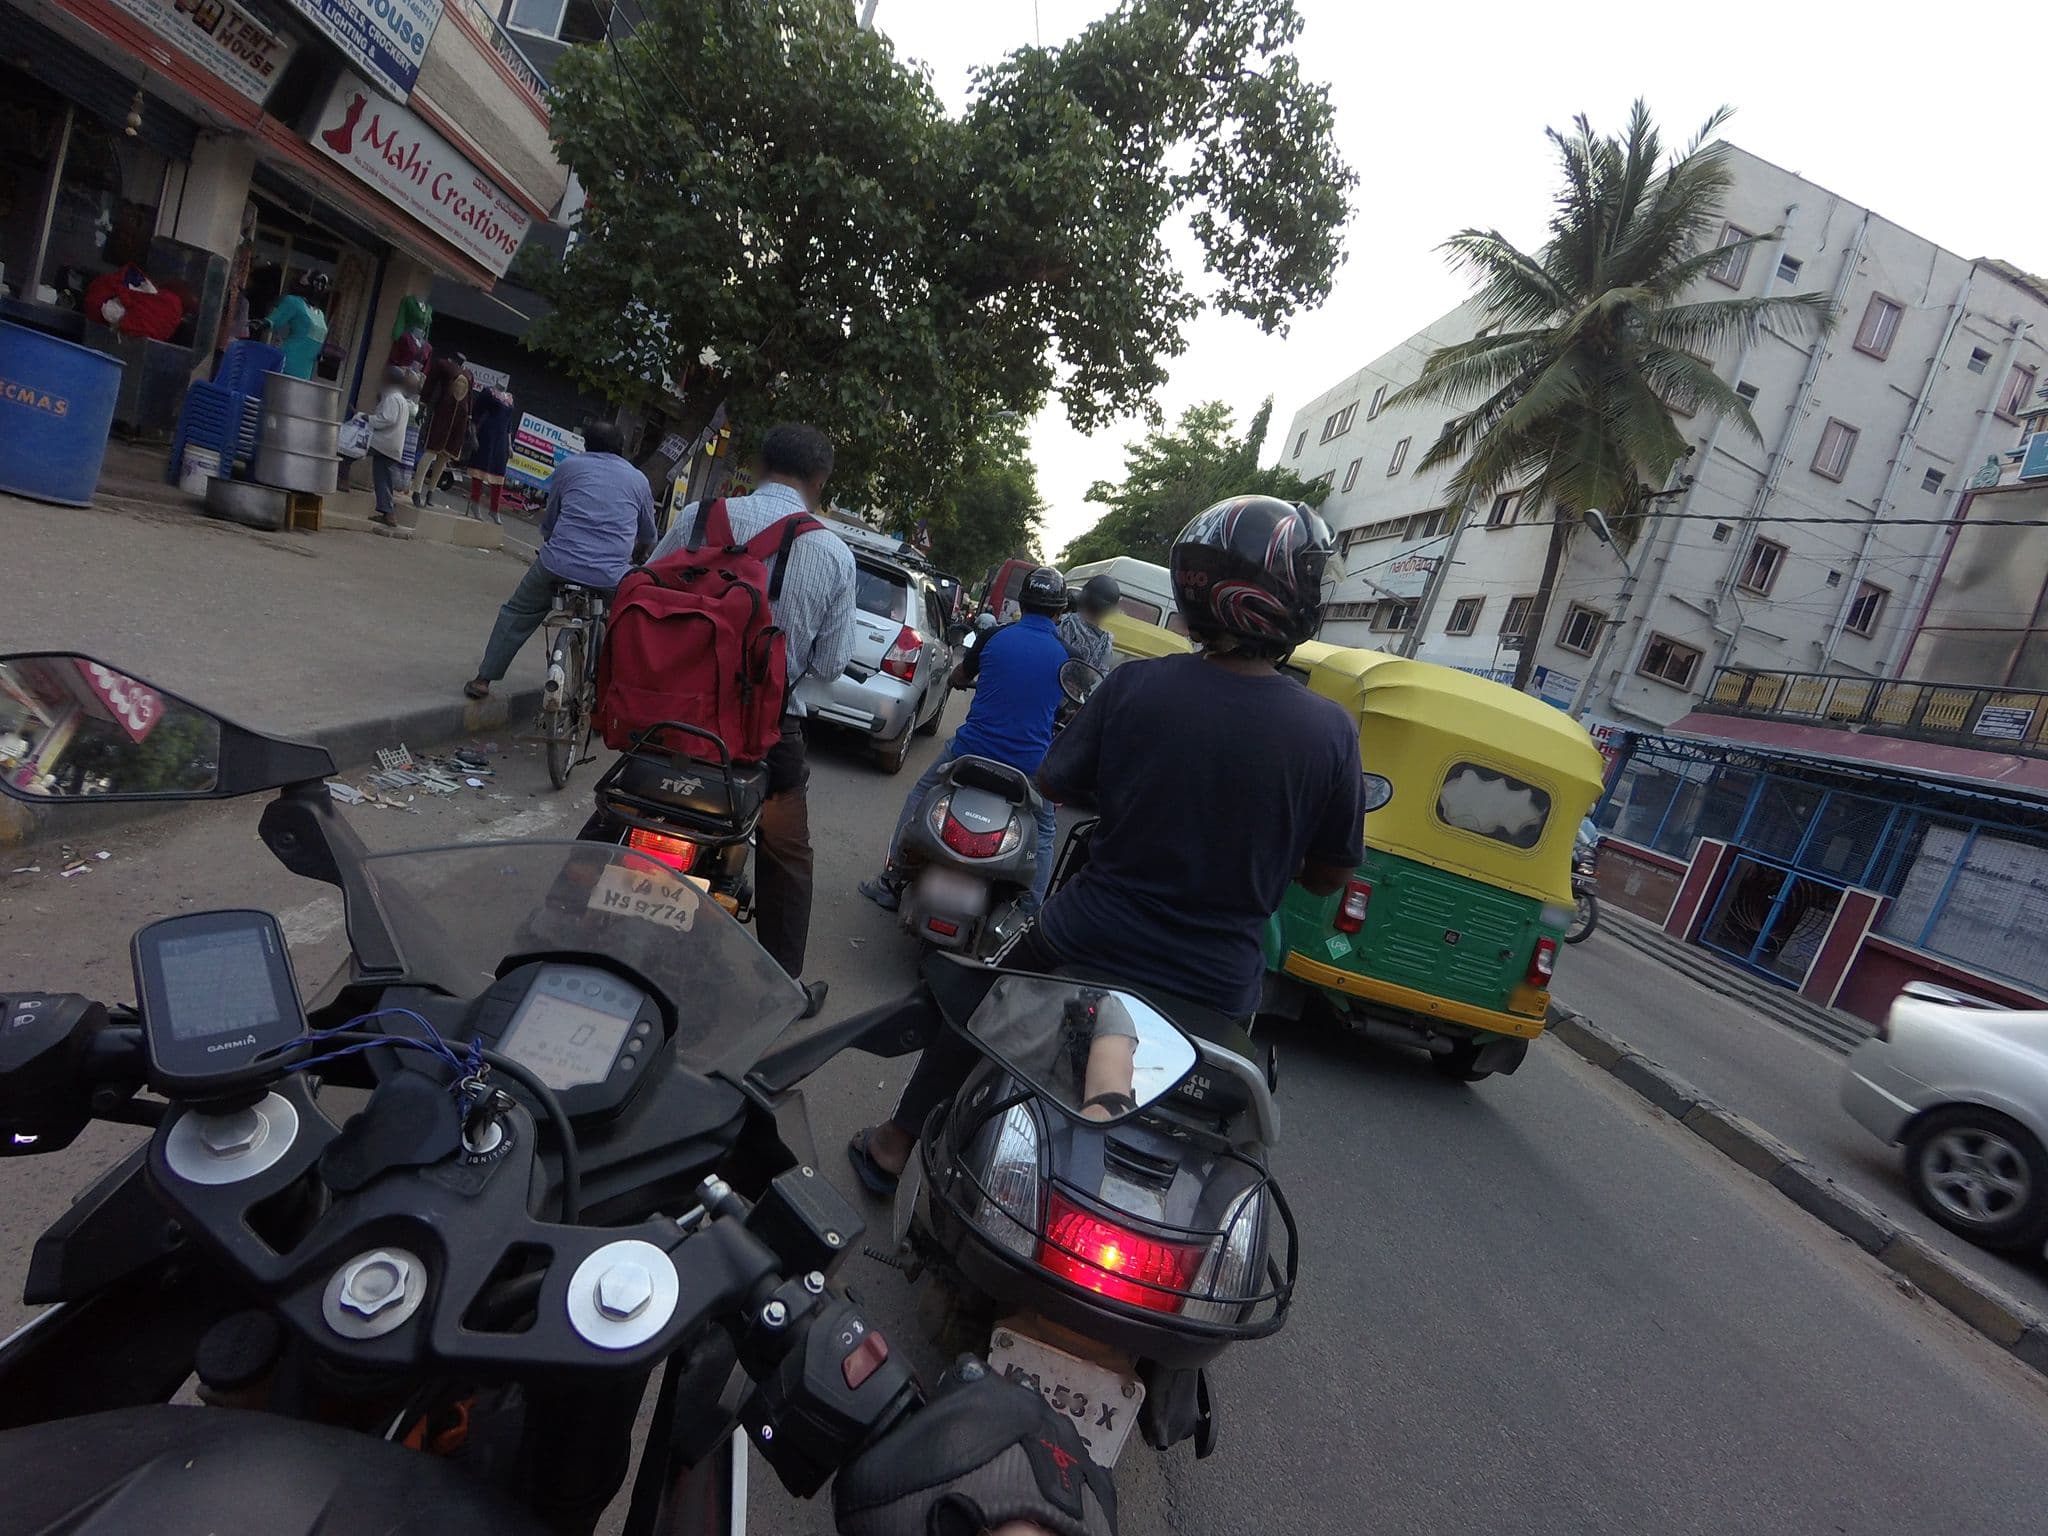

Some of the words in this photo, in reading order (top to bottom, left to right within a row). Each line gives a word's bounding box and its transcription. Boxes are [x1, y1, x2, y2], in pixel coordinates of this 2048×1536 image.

[227, 11, 277, 52] TENT
[325, 2, 368, 50] LIGHTING
[368, 45, 376, 59] &
[217, 29, 275, 77] HOUSE
[368, 25, 411, 75] CROCKERY,
[361, 114, 432, 186] Mahi
[431, 172, 518, 255] Creations
[522, 417, 563, 442] DIGITAL
[660, 777, 697, 796] TVS
[207, 1034, 256, 1053] GARMIN
[468, 1139, 512, 1164] IGNITION
[1095, 1402, 1118, 1432] X
